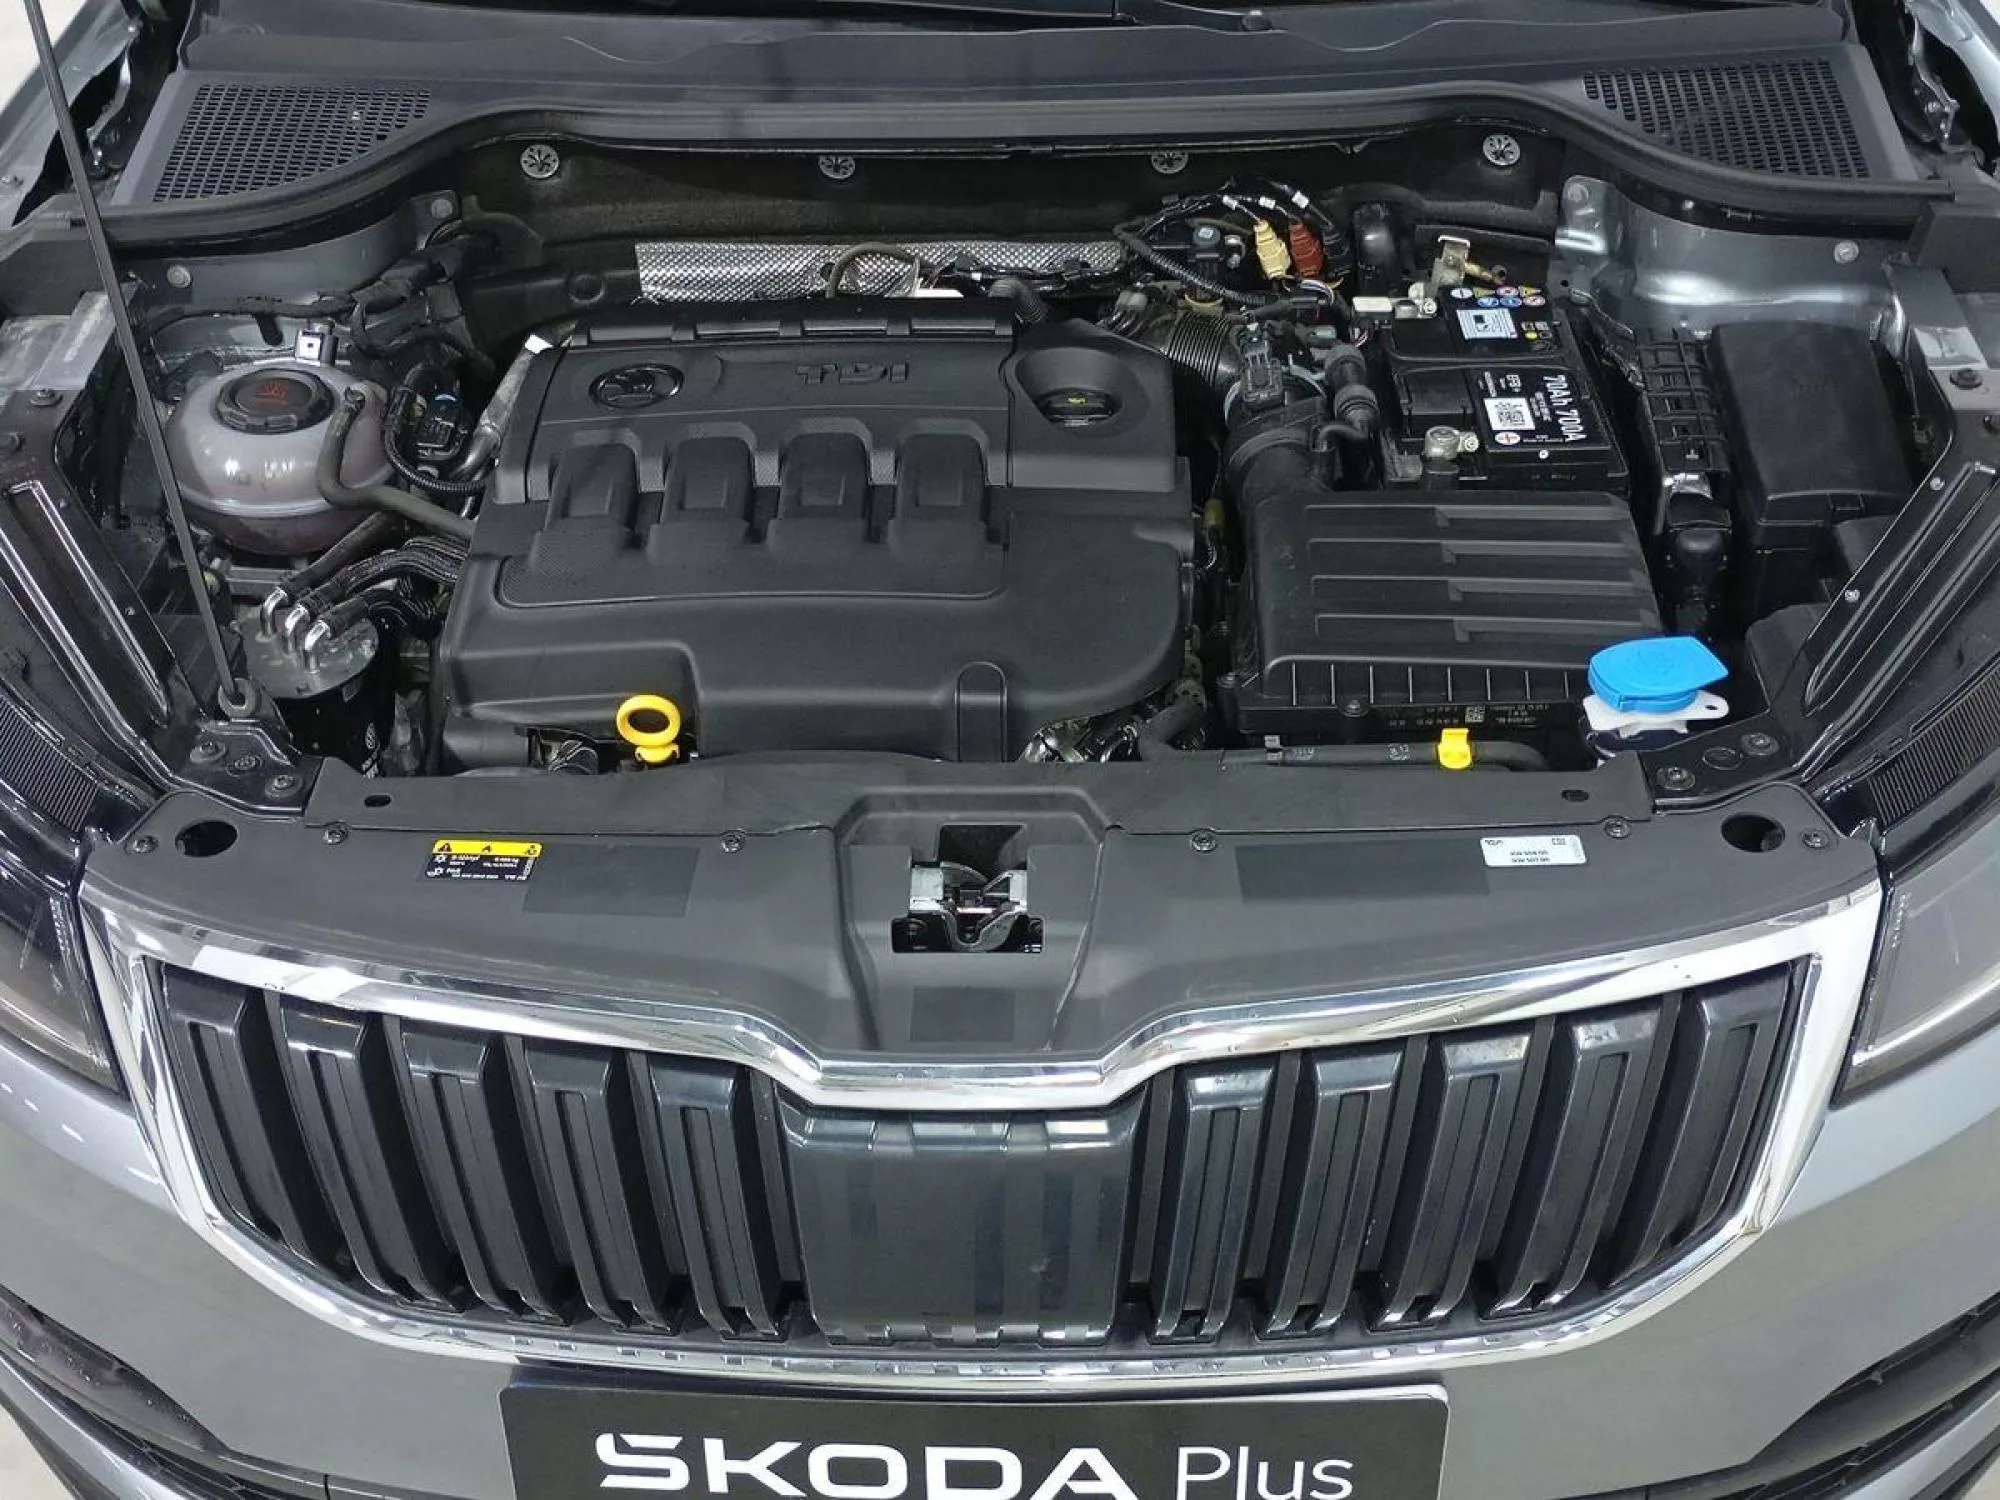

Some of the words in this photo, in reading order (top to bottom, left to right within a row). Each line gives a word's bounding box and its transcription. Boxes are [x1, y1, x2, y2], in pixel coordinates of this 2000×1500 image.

[796, 360, 910, 385] TDI
[1542, 374, 1573, 406] 70Ah
[1556, 409, 1588, 442] 700A
[1177, 1446, 1355, 1500] Plus
